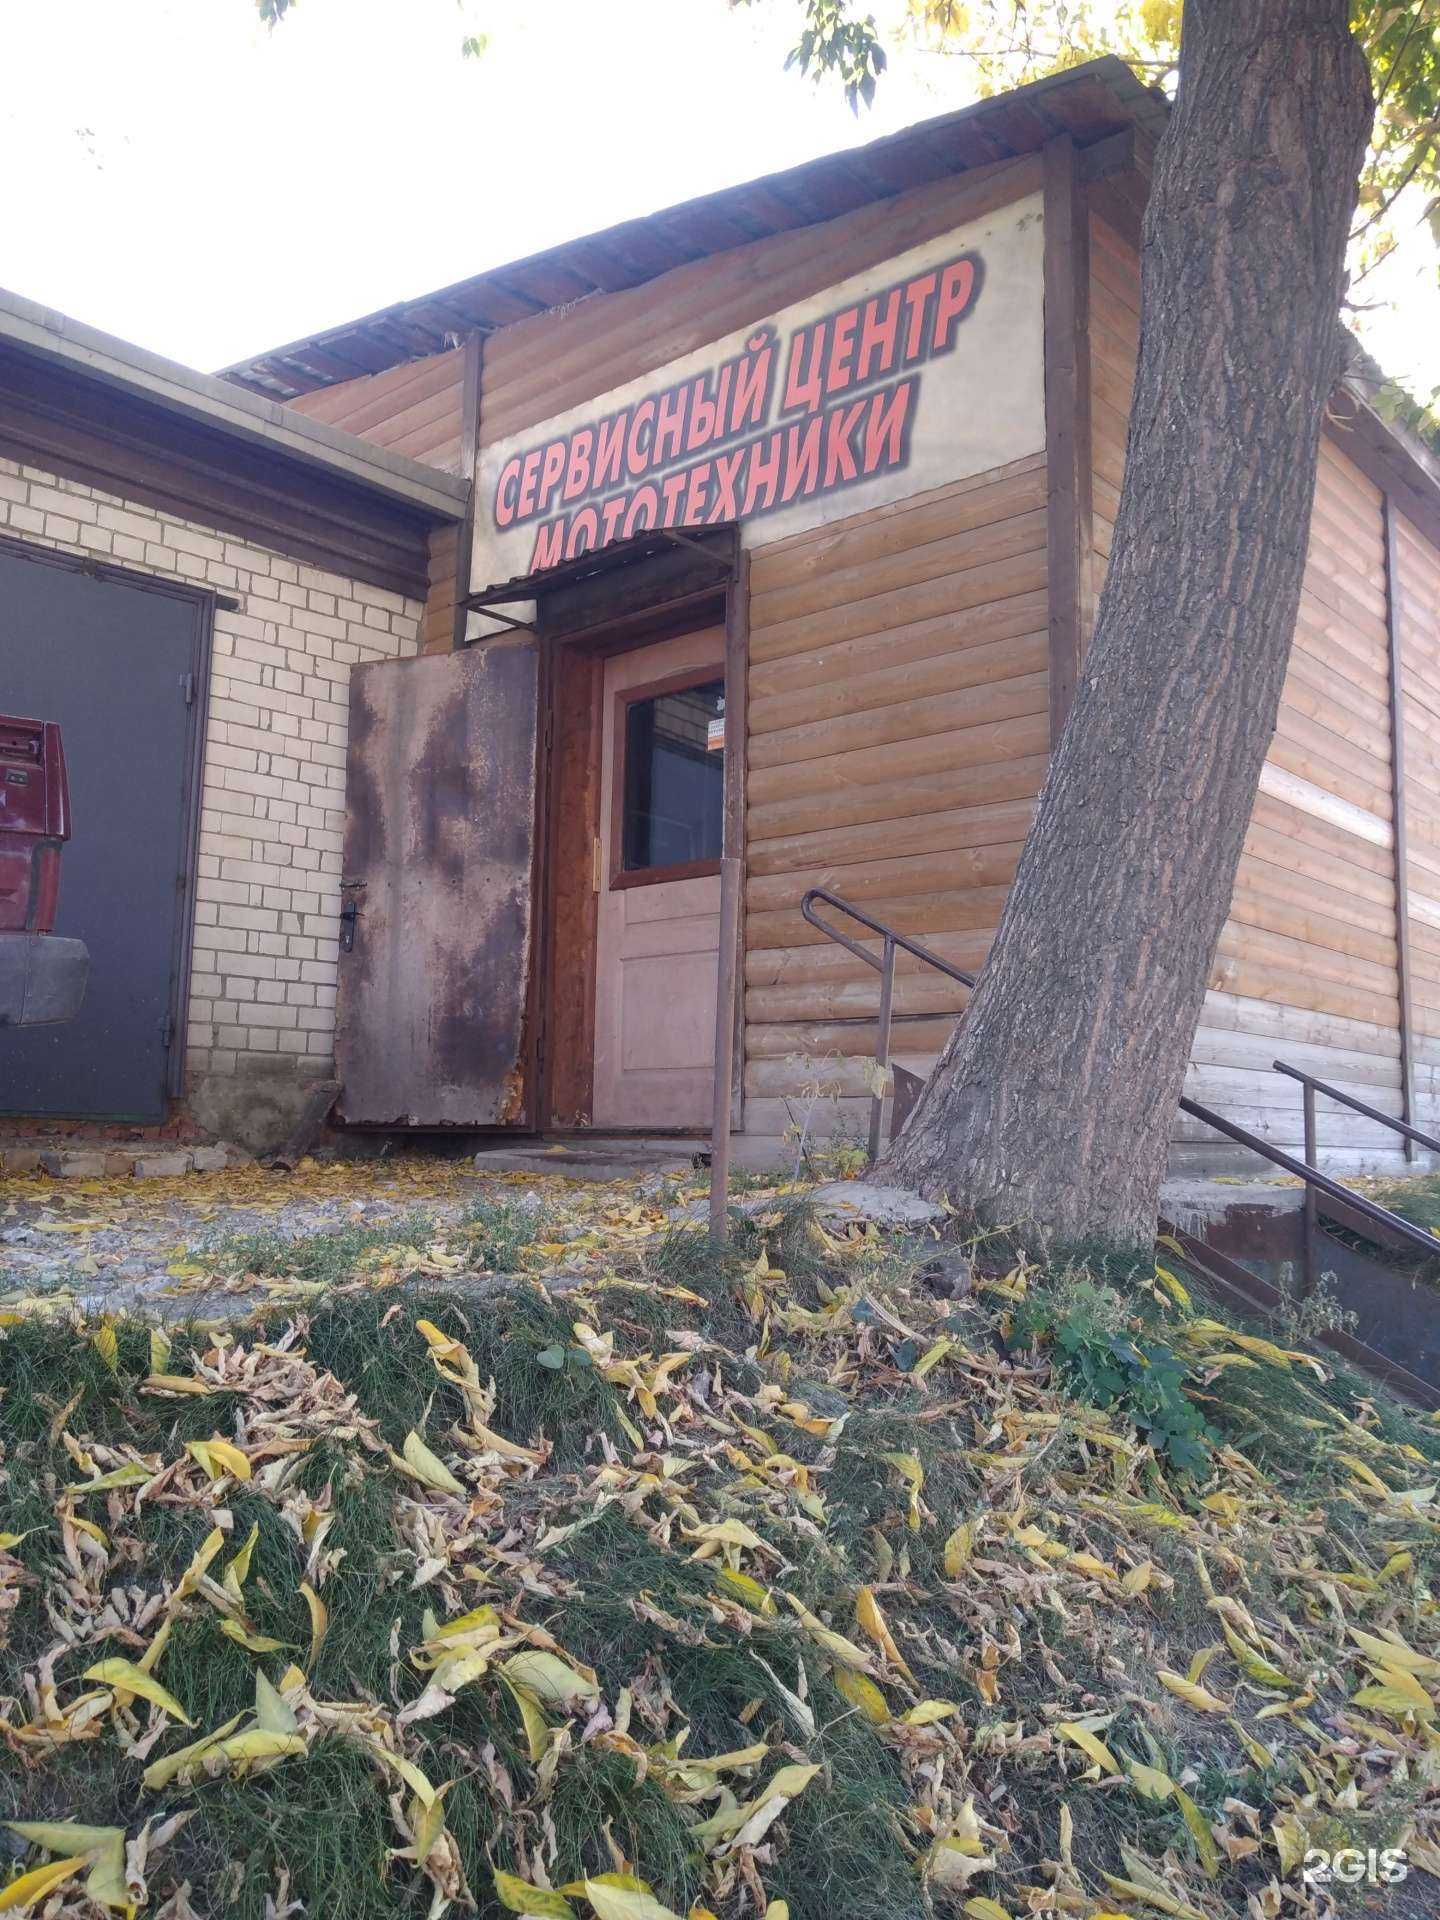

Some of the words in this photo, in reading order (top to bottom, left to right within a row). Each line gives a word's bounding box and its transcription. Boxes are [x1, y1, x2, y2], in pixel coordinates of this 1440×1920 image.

[495, 332, 773, 527] СЕРВИСНЫЙ
[784, 259, 975, 415] ЦЕНТР
[529, 382, 912, 575] МОТОТЕХНИКИ
